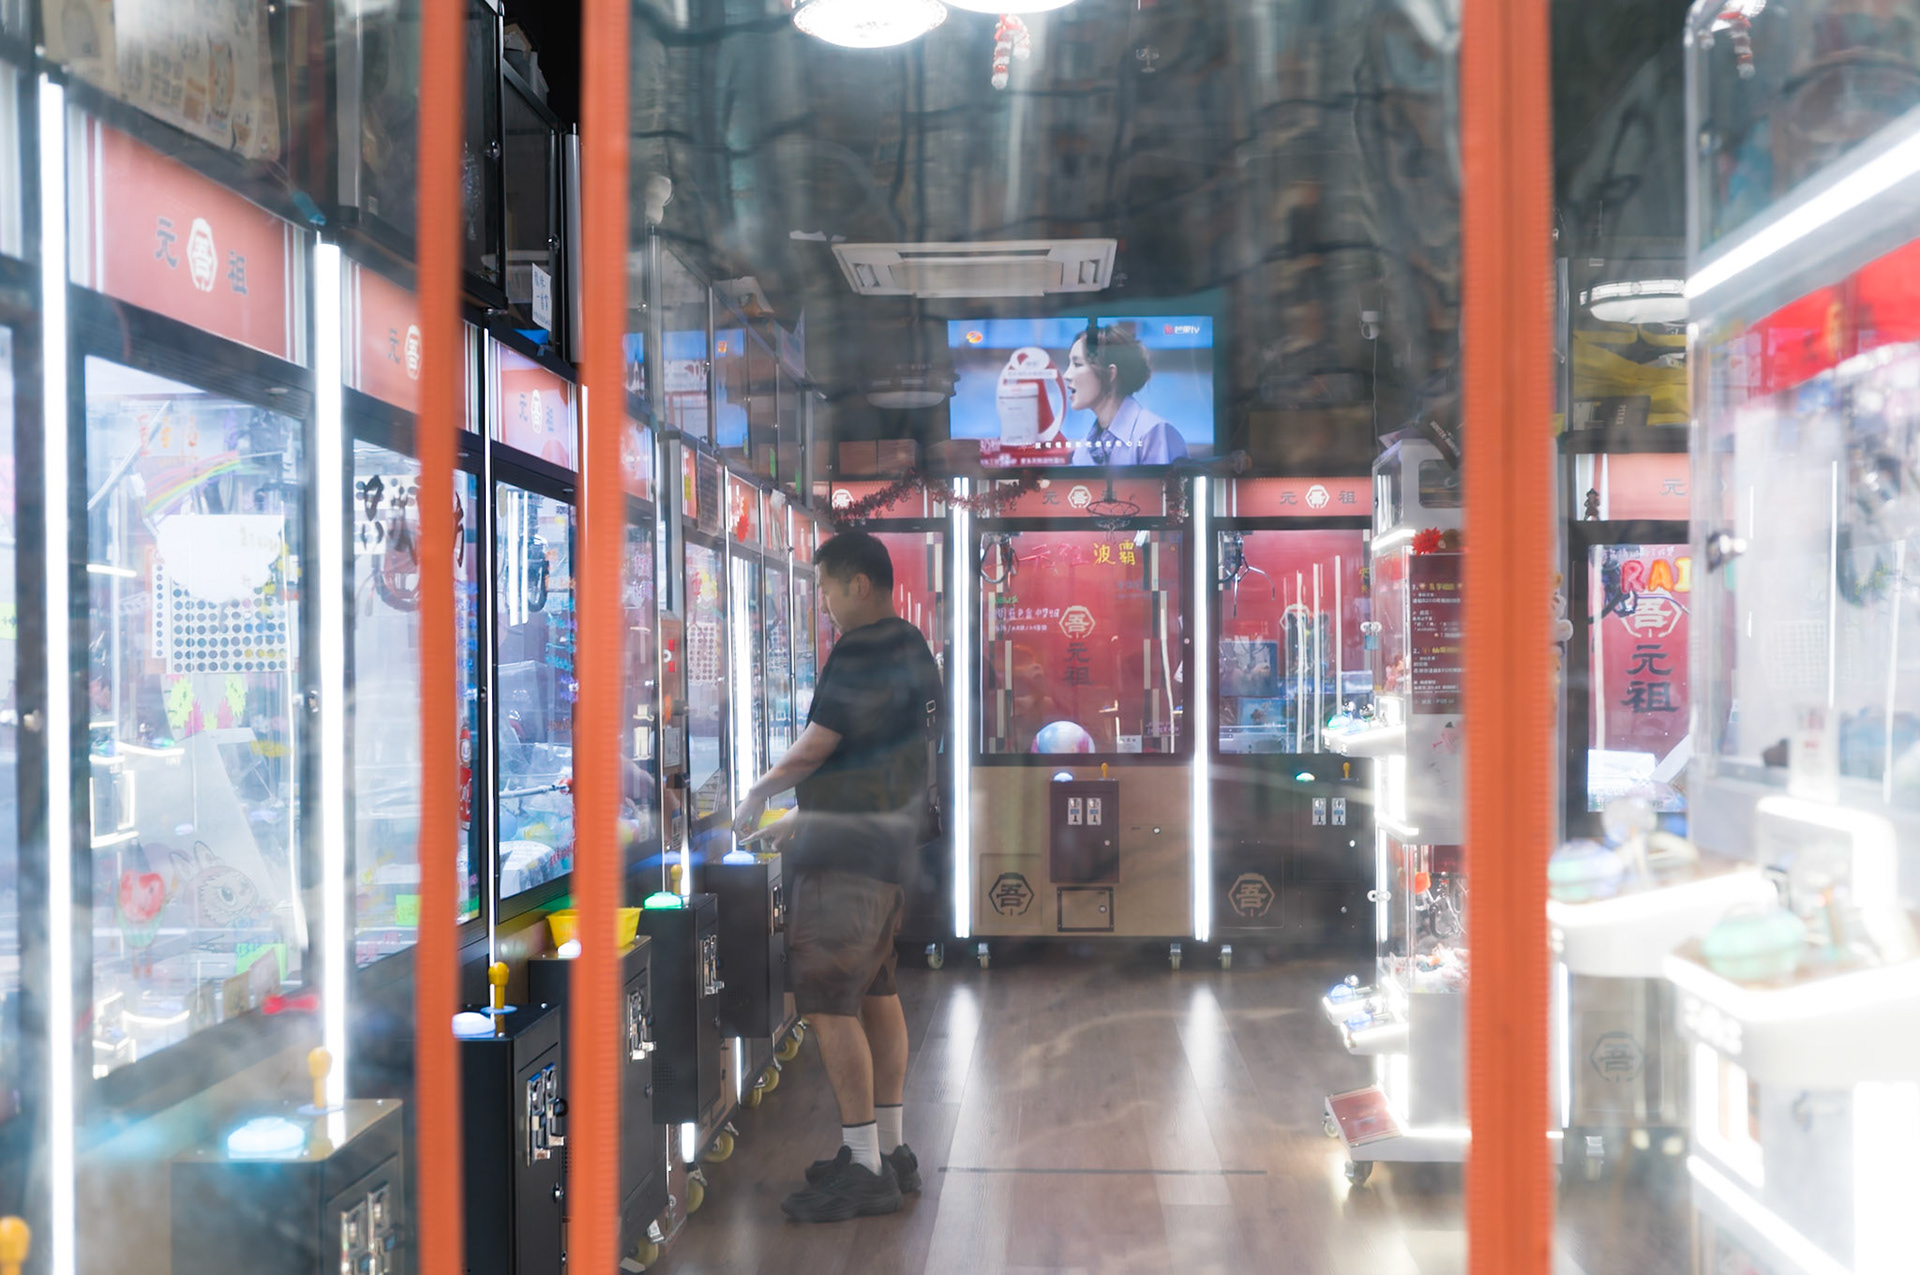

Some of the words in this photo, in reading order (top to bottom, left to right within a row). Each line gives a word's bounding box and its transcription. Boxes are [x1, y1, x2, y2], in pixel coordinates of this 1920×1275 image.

[154, 215, 178, 269] 元
[227, 249, 248, 296] 祖
[1042, 490, 1060, 505] 元
[1279, 490, 1298, 505] 元
[1338, 489, 1356, 505] 祖
[1659, 478, 1688, 497] 元
[1093, 540, 1136, 566] 波霸
[1061, 641, 1095, 687] 元祖
[1620, 643, 1679, 714] 元祖
